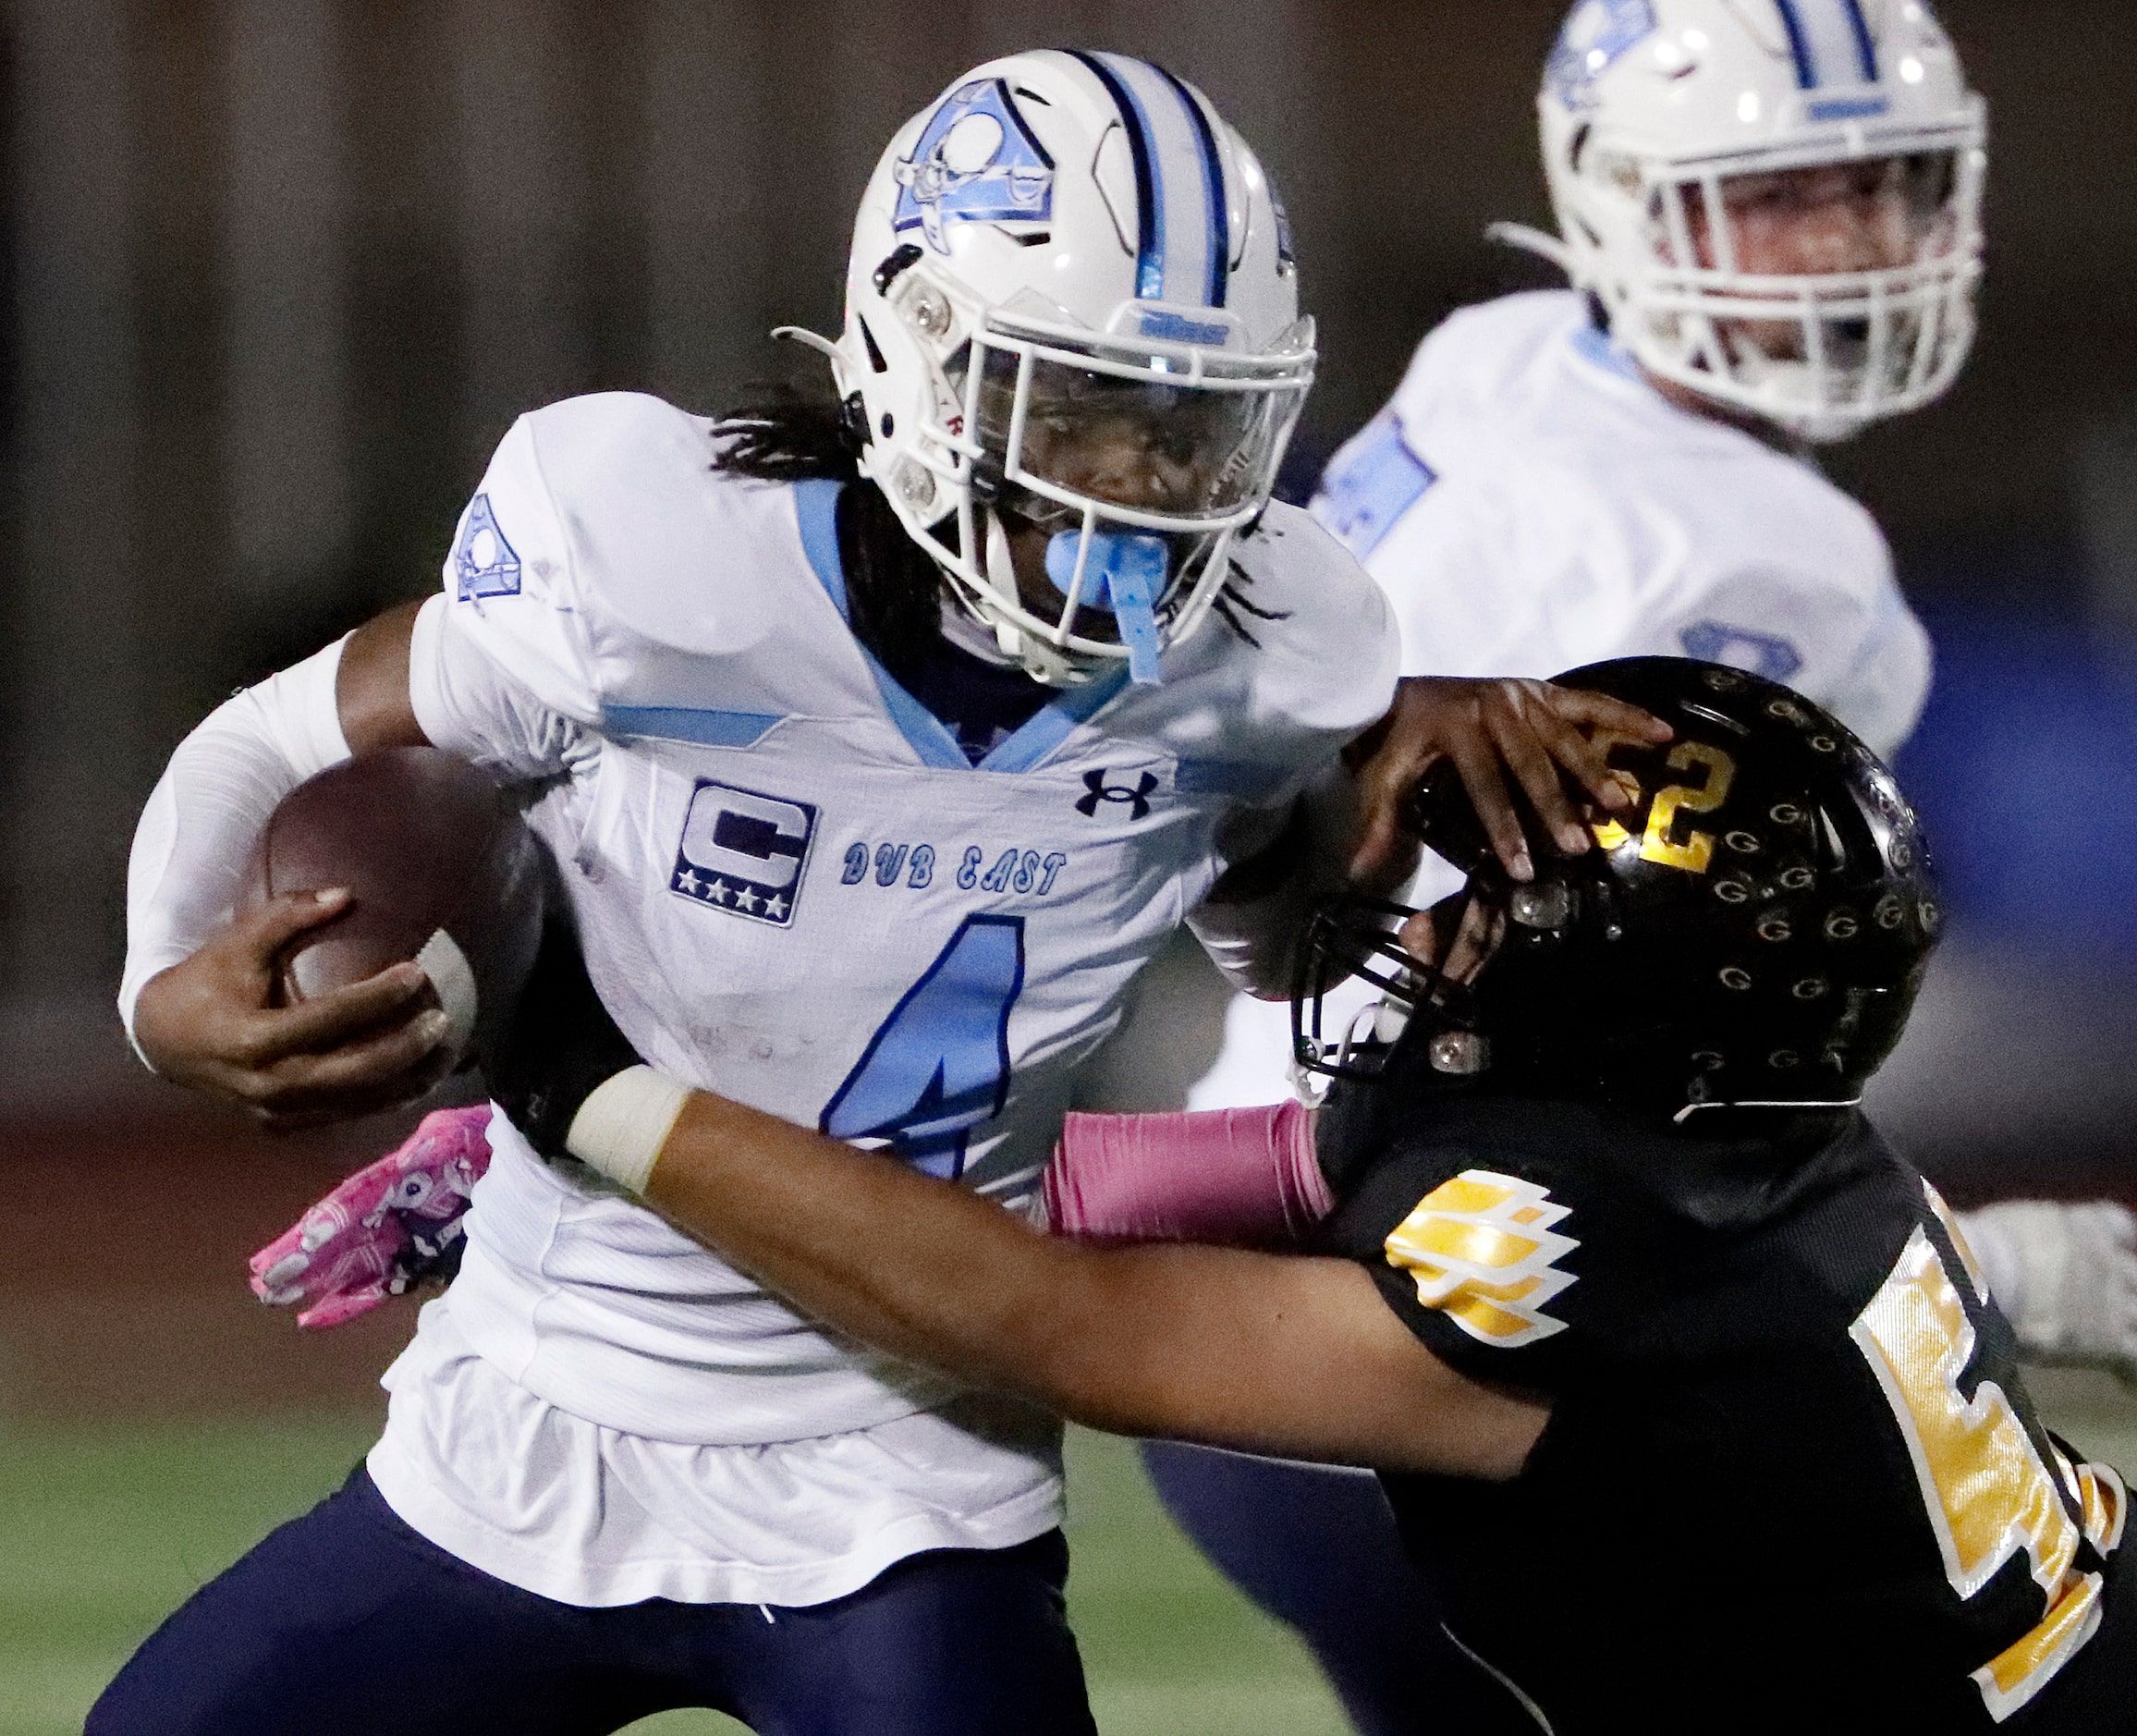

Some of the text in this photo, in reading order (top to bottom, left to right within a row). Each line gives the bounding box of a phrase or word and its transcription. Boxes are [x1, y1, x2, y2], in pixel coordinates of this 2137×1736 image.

[681, 785, 810, 888] C
[840, 841, 1067, 896] DUB EAST
[819, 913, 1024, 1180] 4
